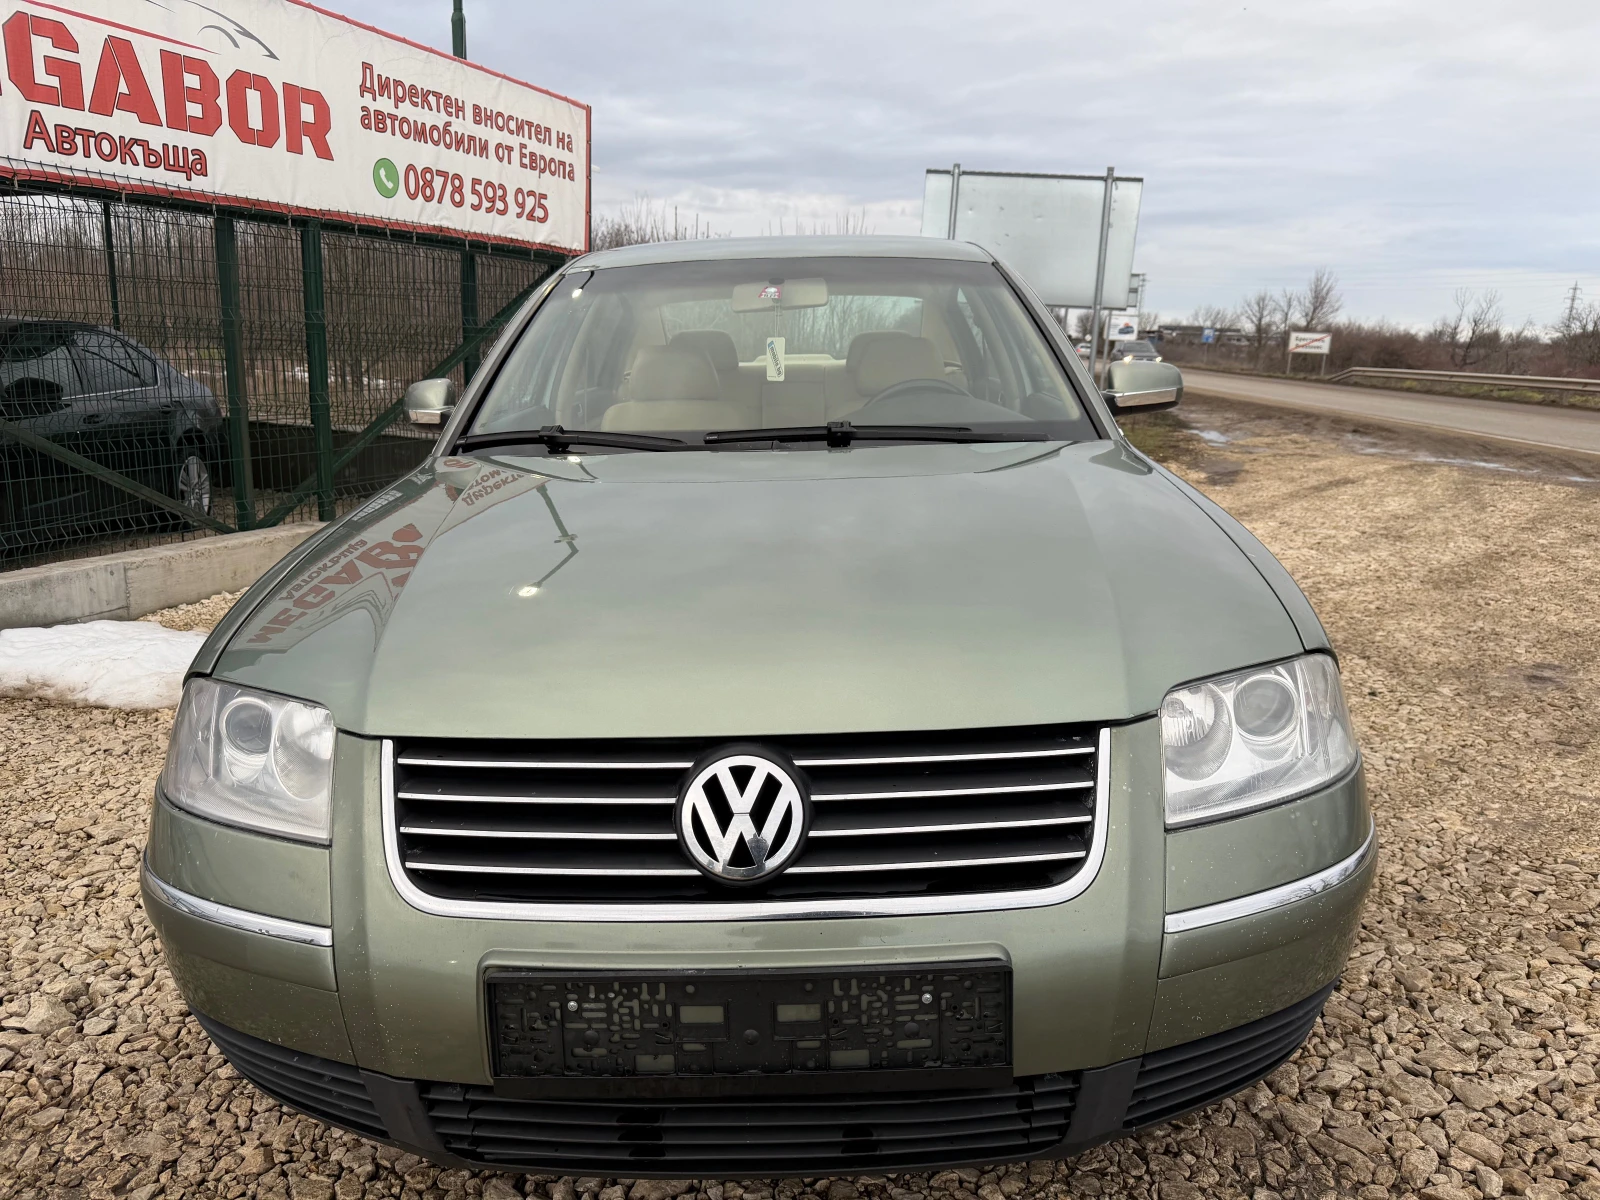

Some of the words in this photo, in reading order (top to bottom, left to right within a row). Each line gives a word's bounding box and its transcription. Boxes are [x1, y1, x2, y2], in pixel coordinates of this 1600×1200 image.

[0, 10, 334, 161] GABOR
[360, 61, 466, 121] Директен
[472, 103, 551, 146] вносител
[556, 130, 574, 153] на
[23, 109, 208, 181] Автокъща
[360, 105, 489, 159] автомобили
[494, 142, 514, 164] от
[519, 142, 575, 181] Европа
[404, 163, 465, 208] 0878
[470, 177, 509, 216] 593
[514, 187, 549, 223] 925
[681, 755, 804, 880] VW
